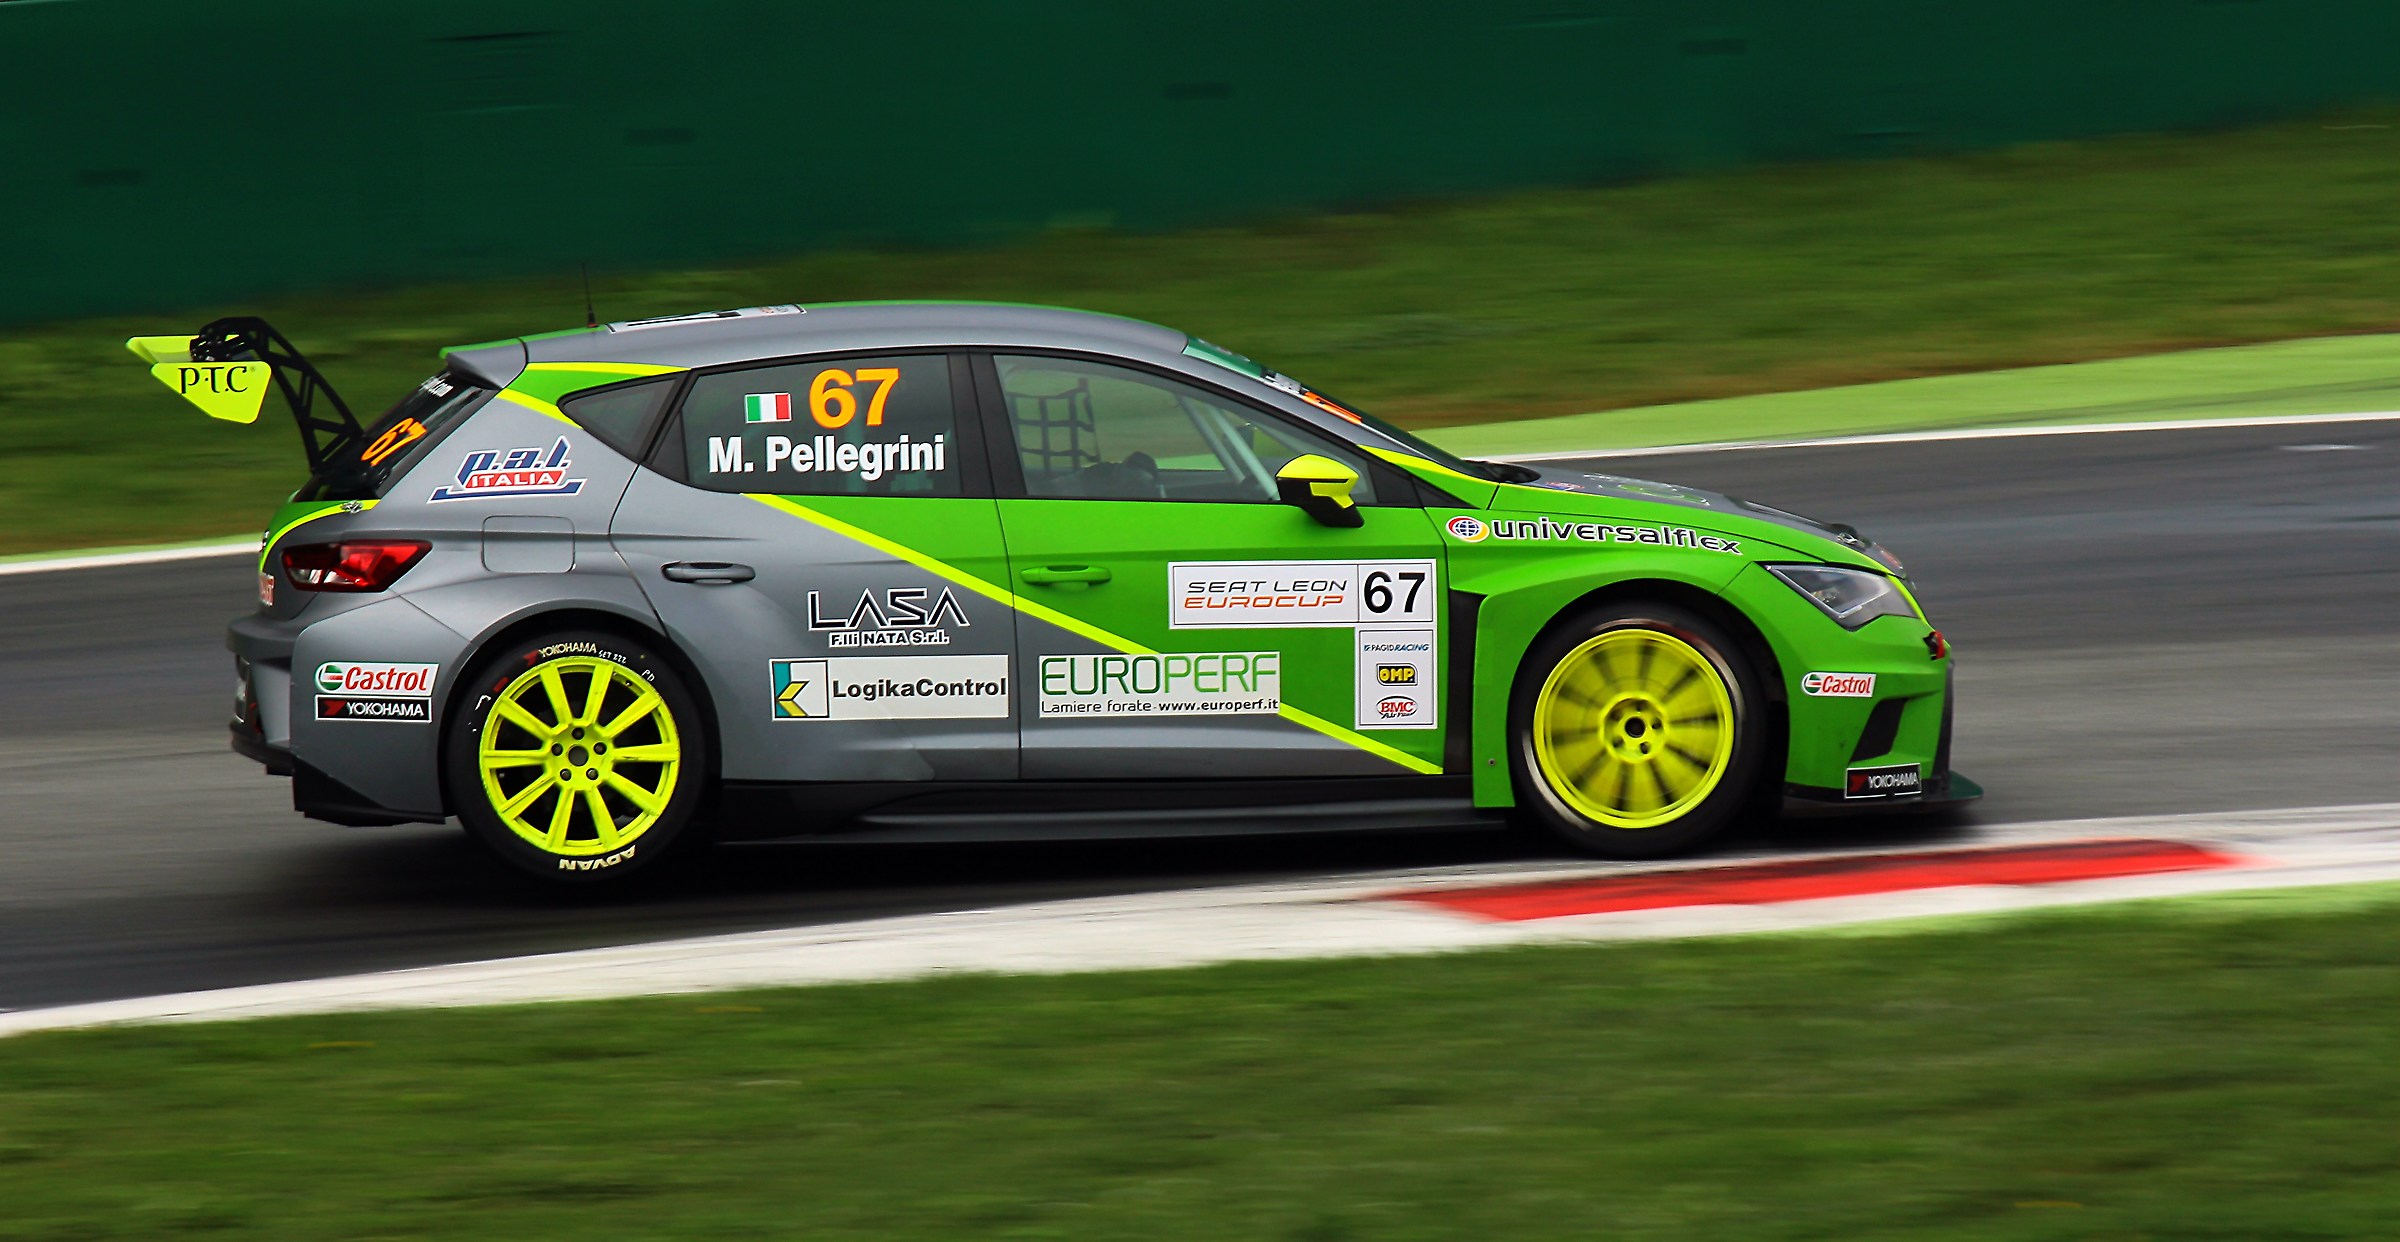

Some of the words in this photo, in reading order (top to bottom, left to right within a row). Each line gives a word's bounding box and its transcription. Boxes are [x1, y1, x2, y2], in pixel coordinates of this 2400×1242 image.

[810, 368, 900, 428] 67
[361, 417, 427, 467] 67
[708, 436, 755, 473] M.
[765, 434, 945, 481] Pellegrini
[471, 472, 555, 487] ITALIA
[1492, 517, 1743, 555] universalflex
[1187, 581, 1266, 593] SEAT
[1273, 580, 1348, 592] LEON
[1363, 571, 1426, 614] 67
[808, 586, 970, 631] LASA
[1184, 595, 1345, 609] EUROCUP
[863, 631, 909, 645] NATA
[912, 629, 950, 645] S.r.l.
[538, 642, 597, 658] YOKOHAMA
[345, 666, 429, 691] Castrol
[1041, 653, 1278, 696] EUROPERF
[1380, 668, 1415, 682] OMP
[832, 677, 1007, 701] LogikaControl
[1822, 675, 1872, 694] Castrol
[346, 701, 424, 717] YOKOHAMA
[1041, 701, 1102, 713] Lamiere
[1380, 701, 1414, 713] BMC
[1868, 772, 1919, 789] YOKOHAMA
[558, 844, 636, 871] ADVAN
